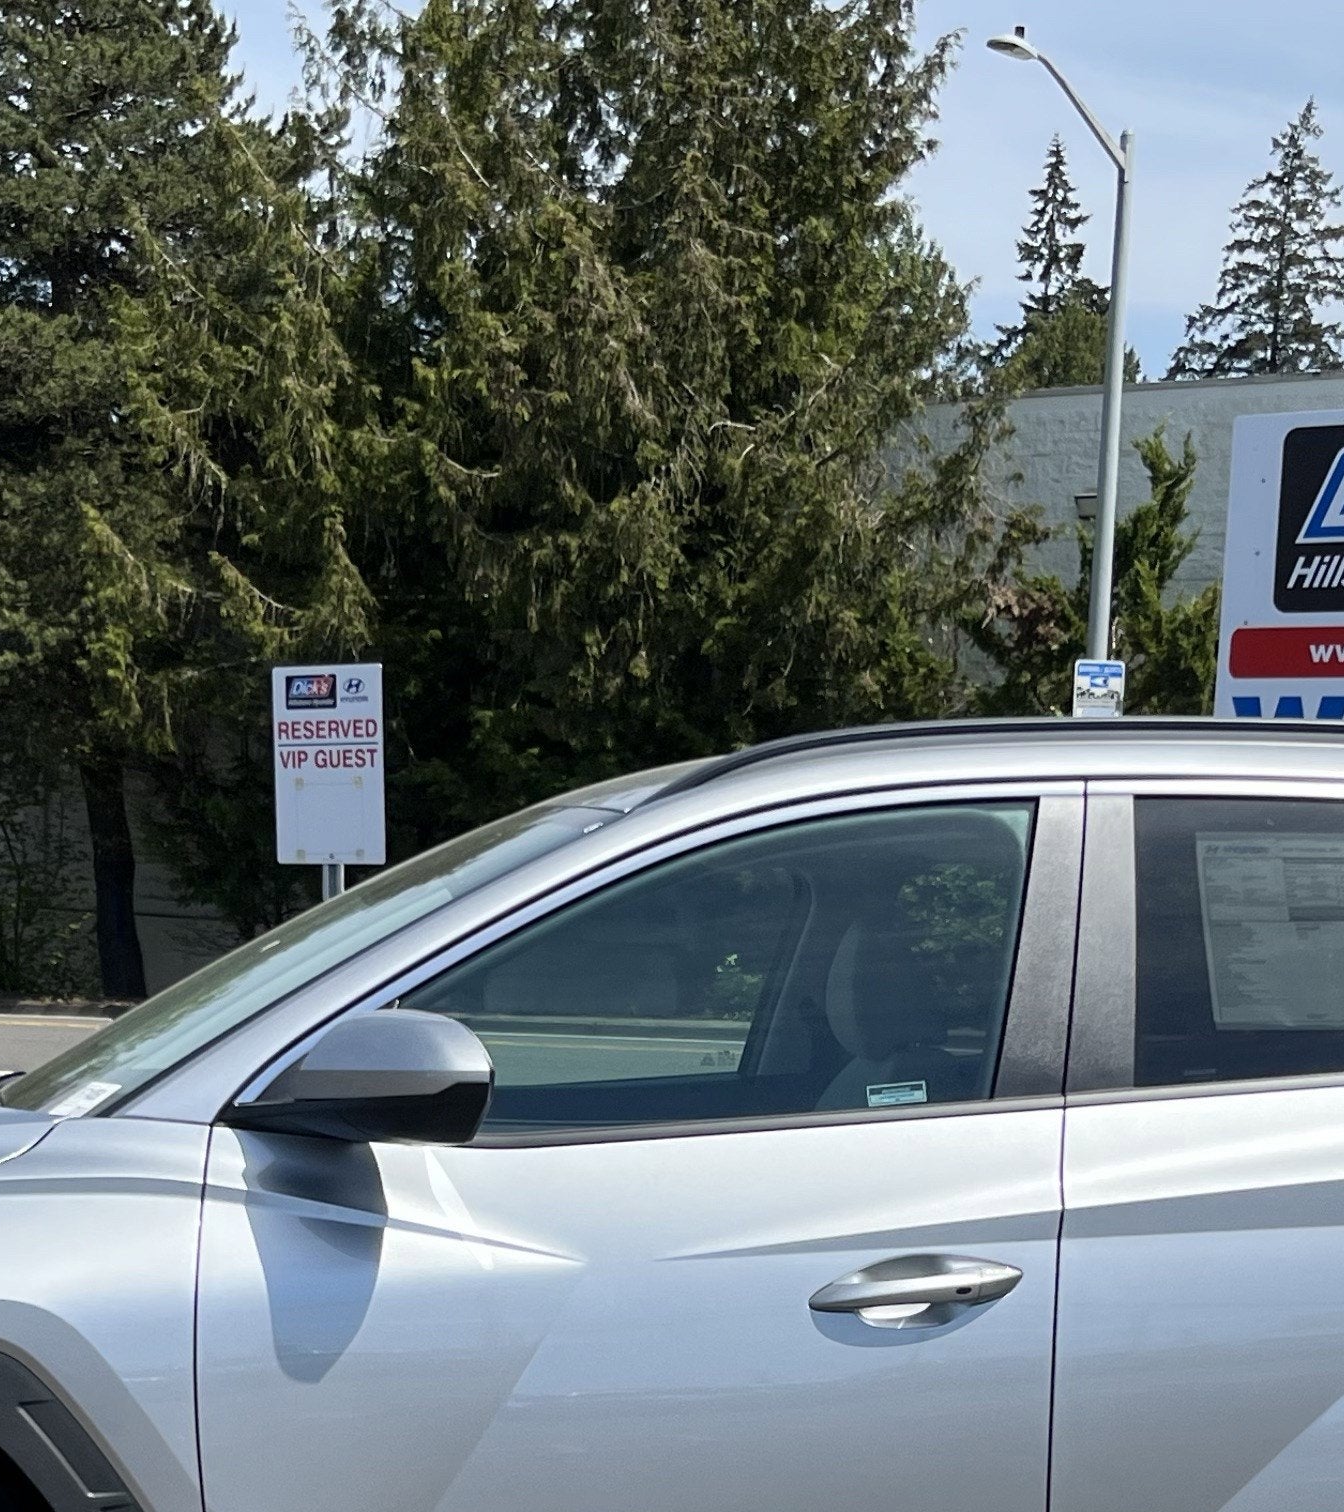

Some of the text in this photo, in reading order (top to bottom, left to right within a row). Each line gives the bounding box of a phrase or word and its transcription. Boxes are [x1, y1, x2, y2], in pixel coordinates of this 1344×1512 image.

[278, 718, 378, 740] RESERVED
[280, 748, 378, 769] VIP GUEST
